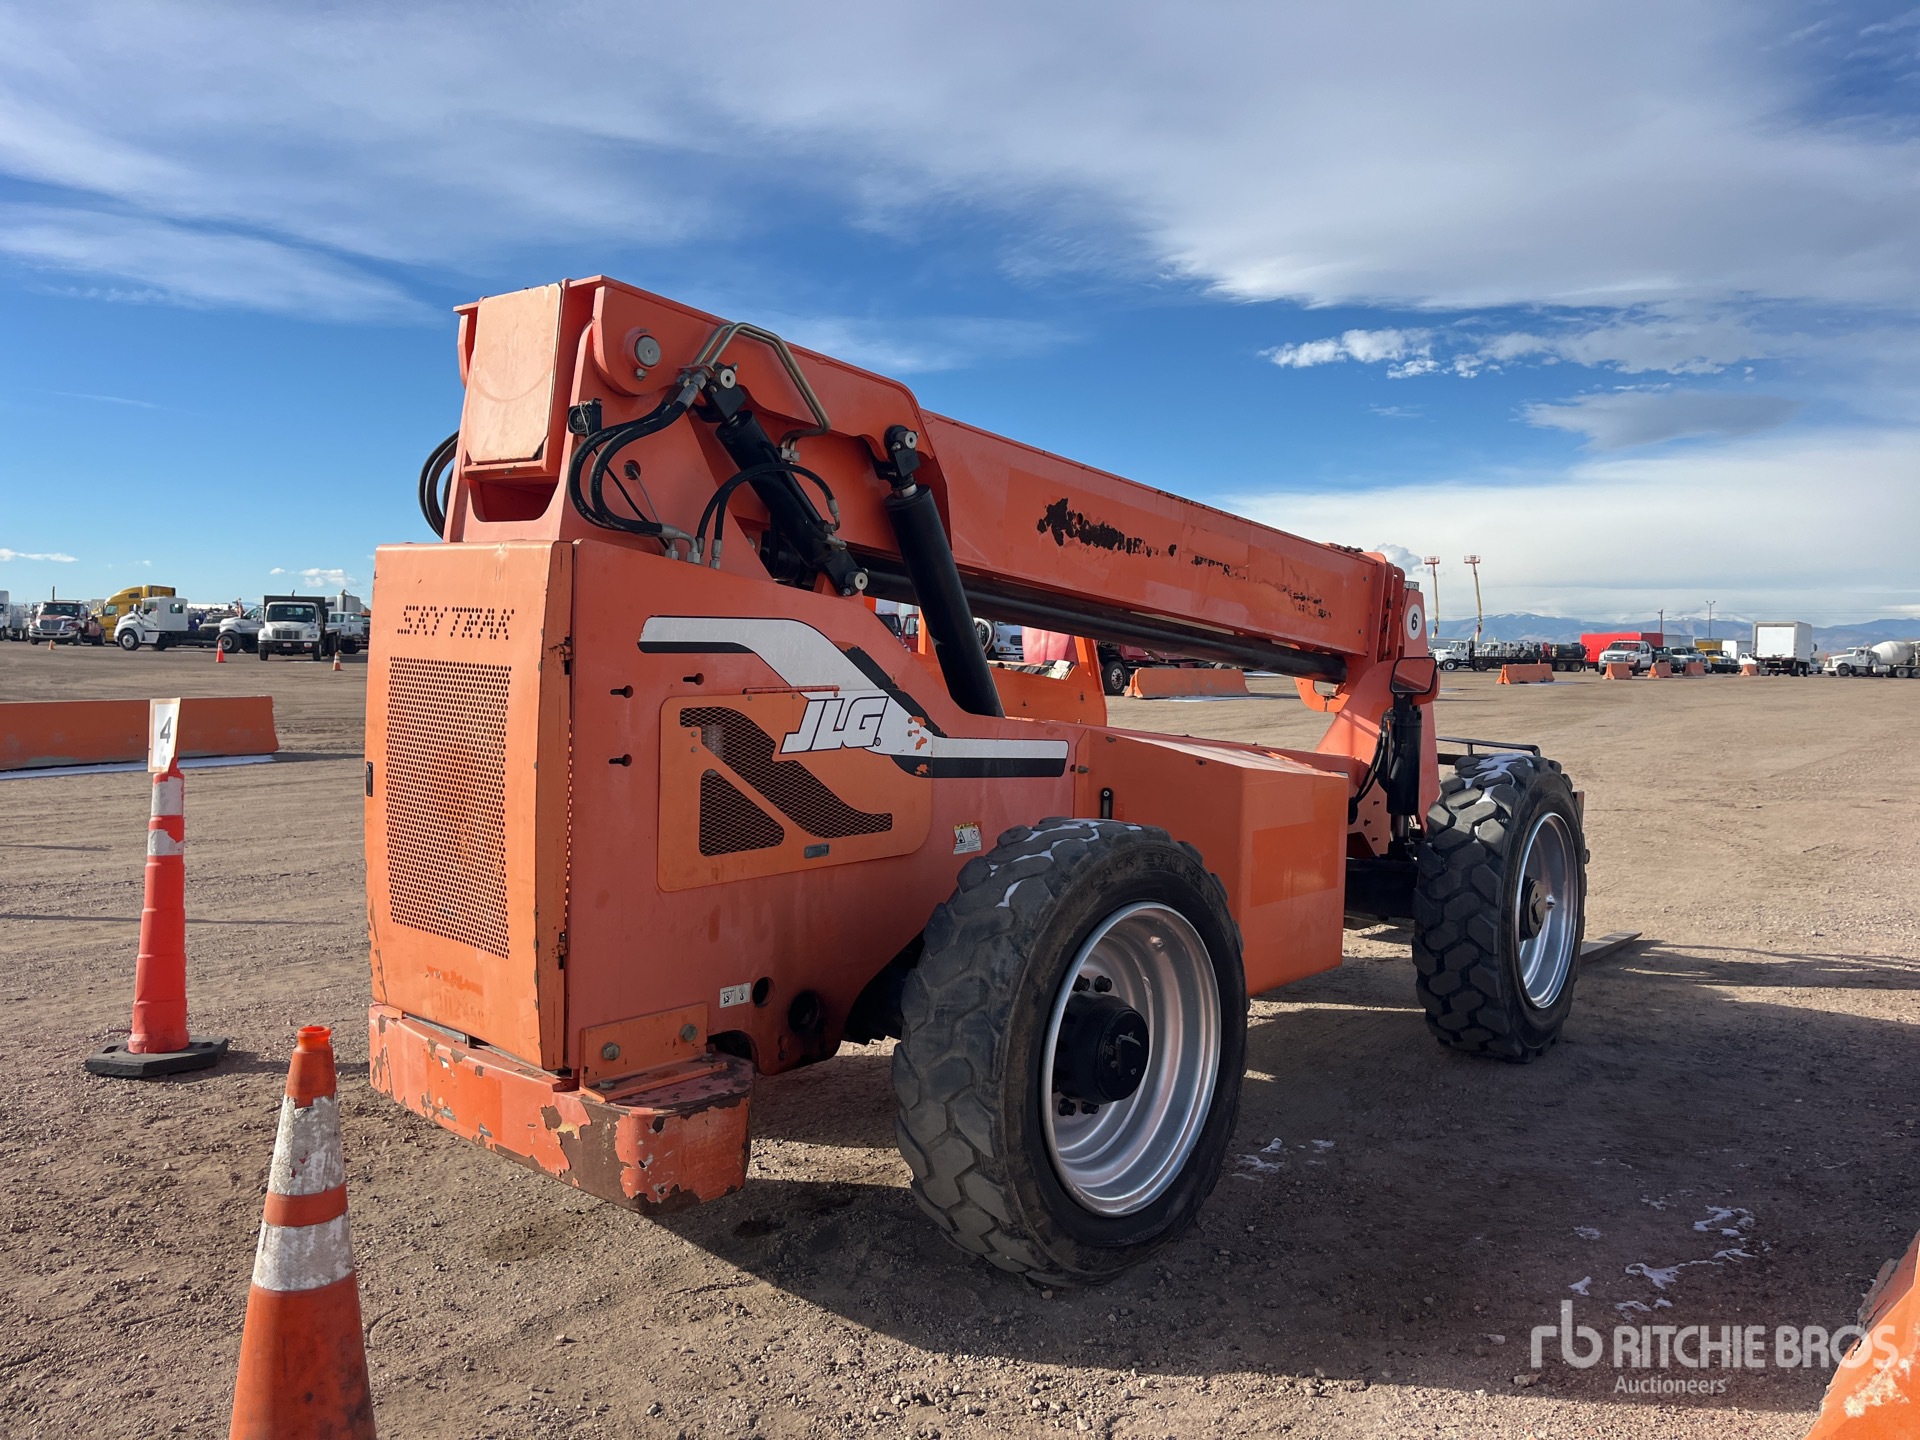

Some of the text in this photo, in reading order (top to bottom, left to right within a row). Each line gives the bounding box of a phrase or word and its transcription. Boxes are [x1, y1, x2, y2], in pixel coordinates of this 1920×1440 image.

[1411, 612, 1418, 631] 6
[159, 716, 172, 744] 4
[779, 696, 889, 754] JLG
